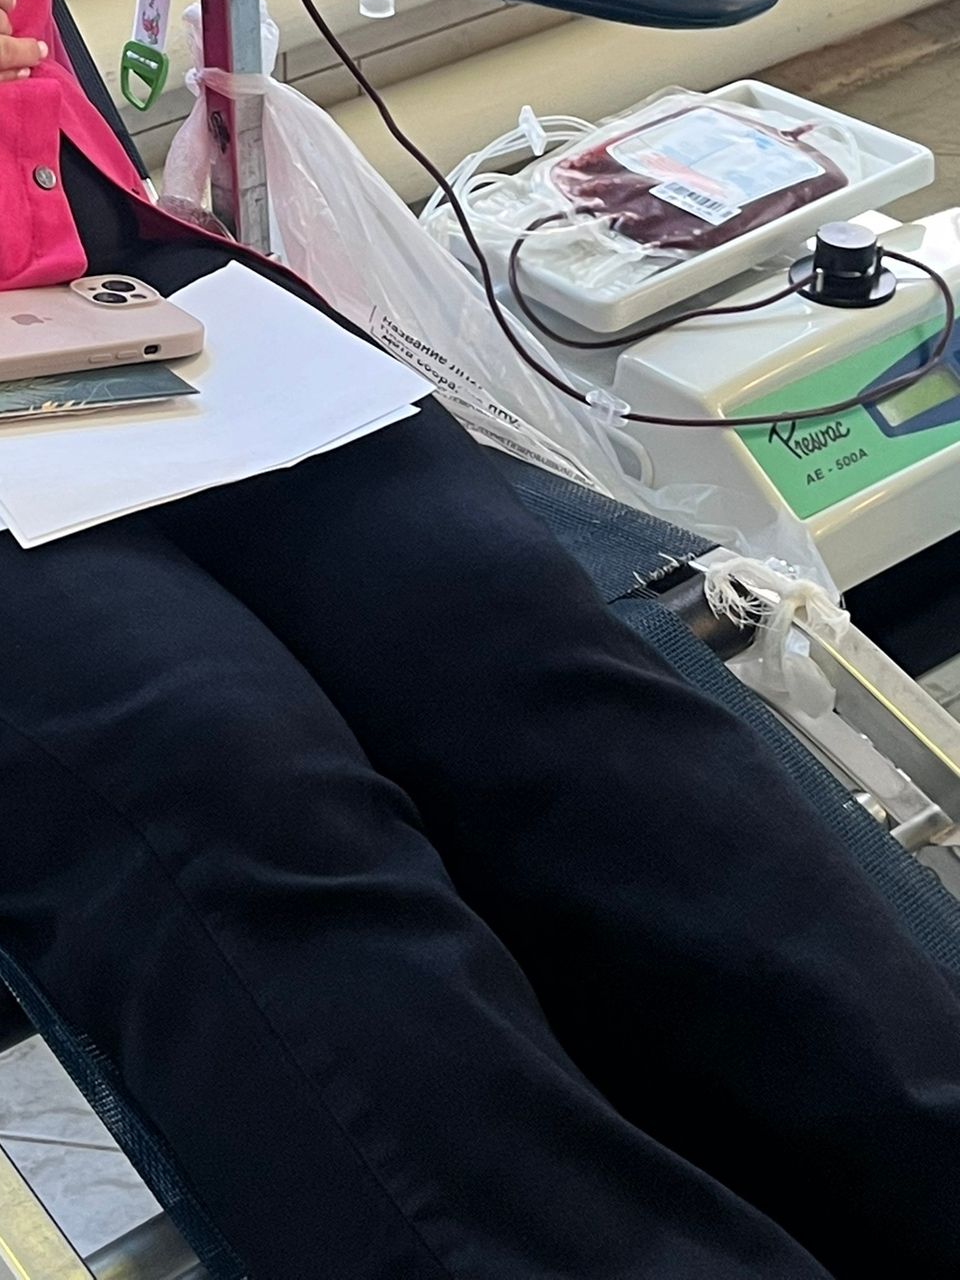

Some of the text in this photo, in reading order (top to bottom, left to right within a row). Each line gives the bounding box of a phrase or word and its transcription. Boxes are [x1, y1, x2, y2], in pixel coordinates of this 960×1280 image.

[768, 420, 851, 460] Presvac
[806, 468, 825, 486] AE
[835, 448, 869, 471] 500A
